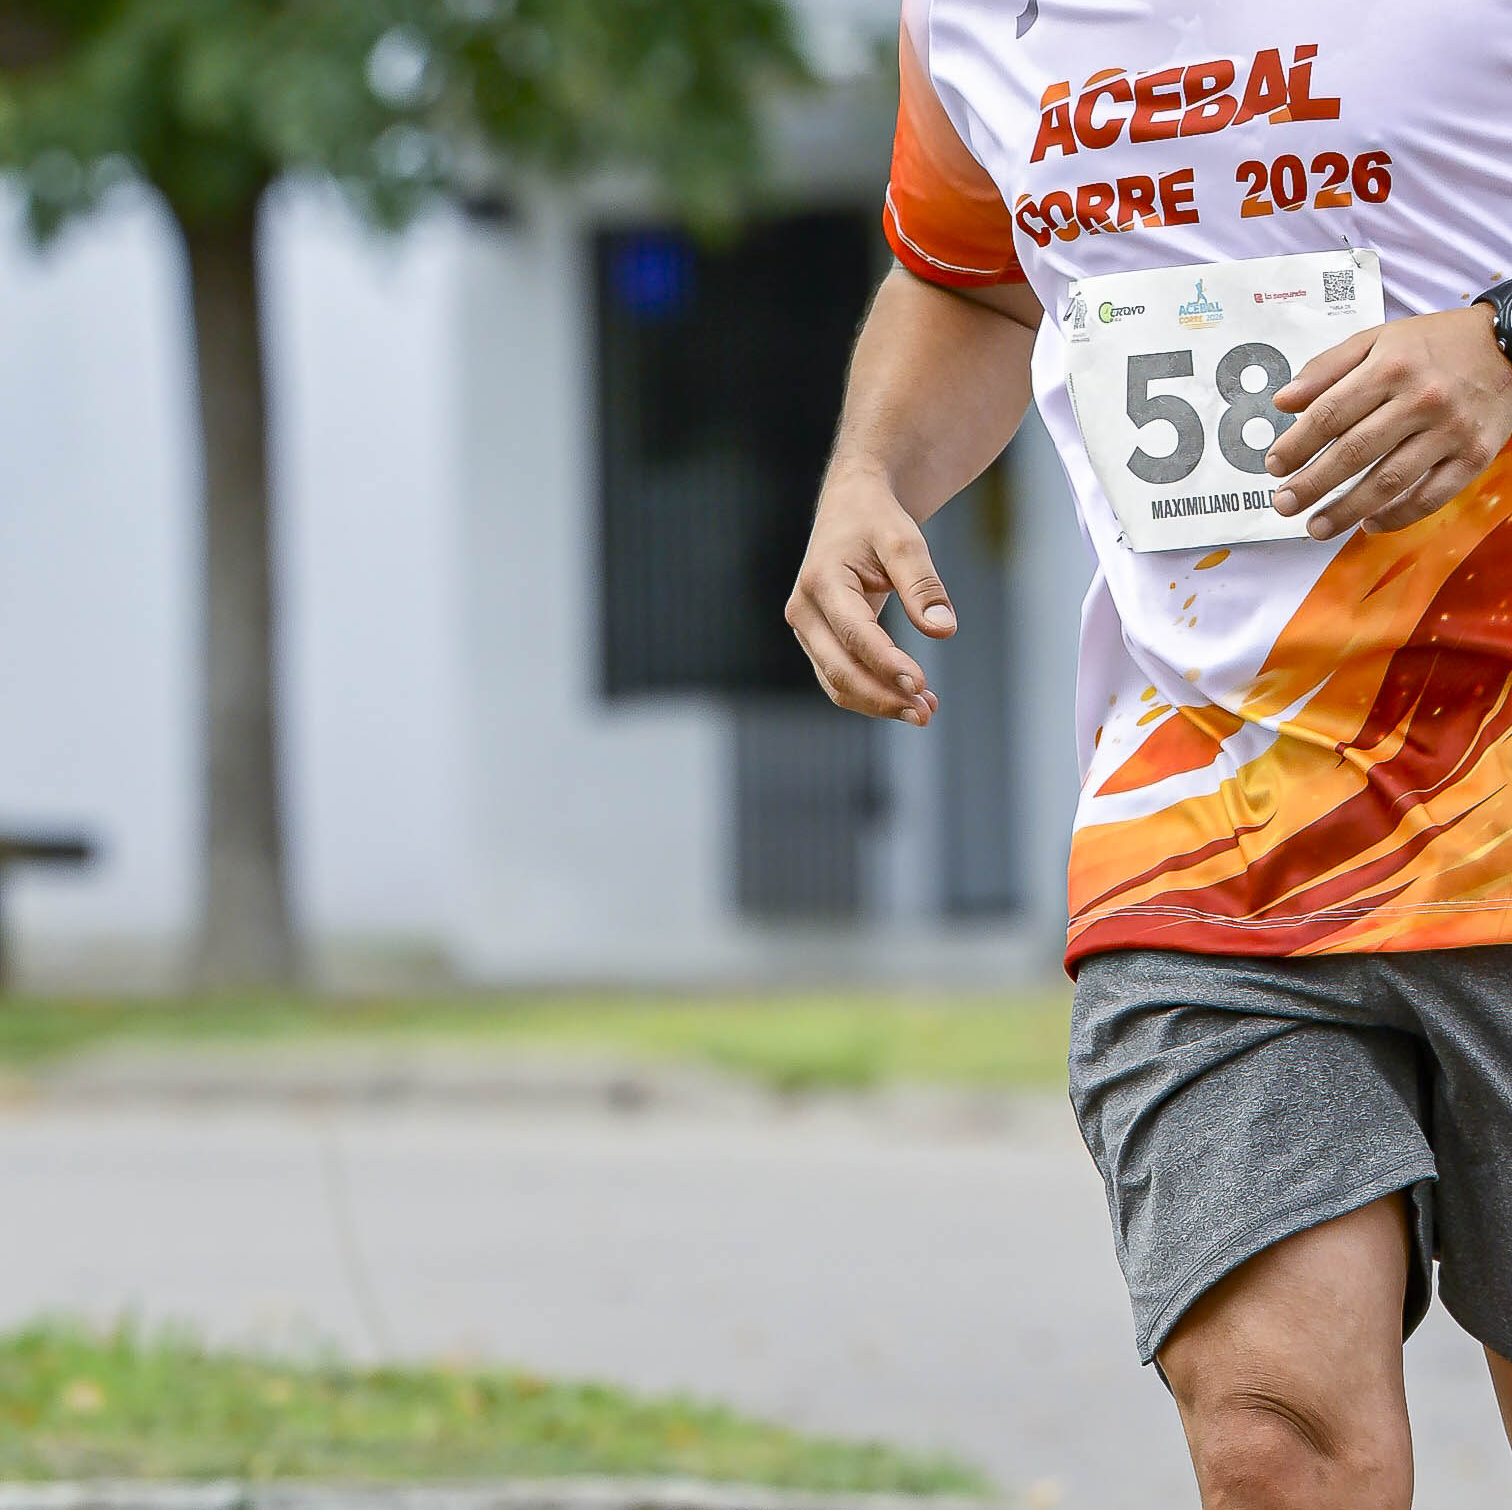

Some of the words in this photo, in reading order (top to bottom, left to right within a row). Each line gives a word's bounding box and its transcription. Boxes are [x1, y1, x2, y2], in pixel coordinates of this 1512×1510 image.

[1030, 44, 1341, 163] ACEBAL
[1015, 168, 1200, 248] CORRE
[1236, 150, 1393, 218] 2026
[1178, 301, 1224, 316] ACEBAL
[1126, 342, 1298, 484] 58
[1151, 493, 1240, 520] MAXIMILIANO
